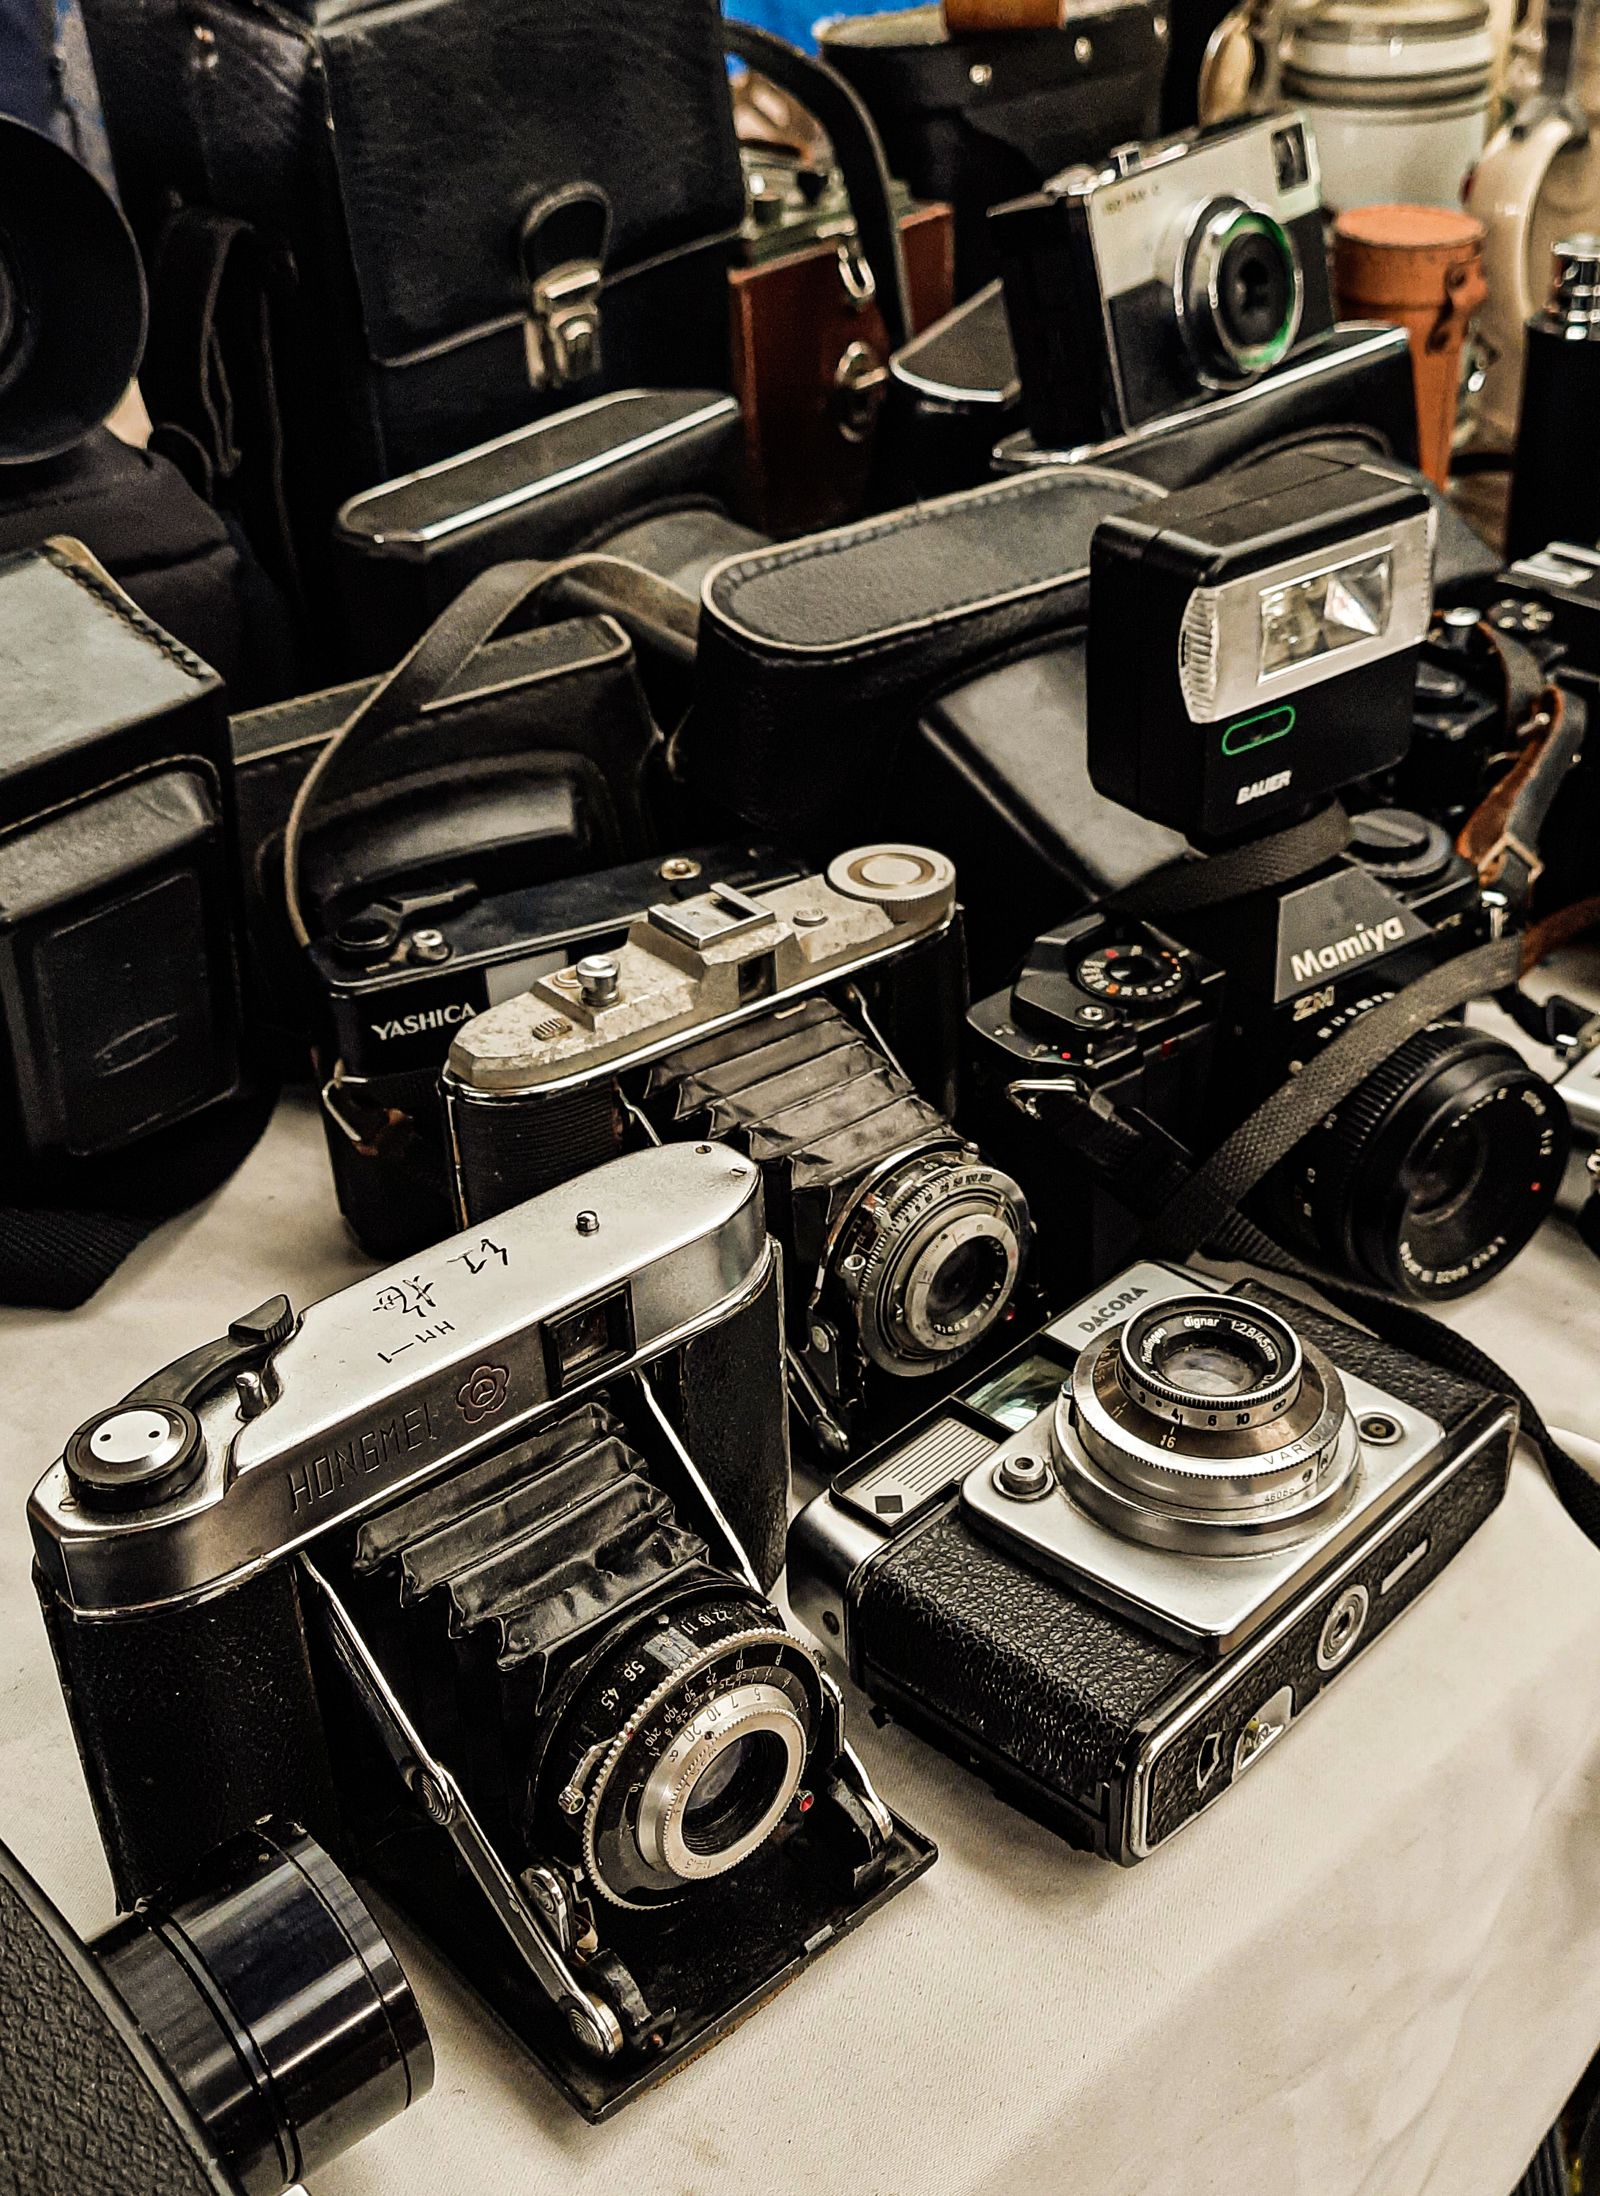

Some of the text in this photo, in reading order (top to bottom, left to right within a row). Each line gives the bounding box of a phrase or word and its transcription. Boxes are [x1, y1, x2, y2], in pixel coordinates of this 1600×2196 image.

[1290, 916, 1405, 982] Mamiya
[371, 1002, 477, 1040] YASHICA
[1078, 1287, 1148, 1333] DACORA
[1183, 1315, 1219, 1329] dignar
[1207, 1415, 1217, 1427] 6
[1235, 1412, 1250, 1426] 10
[1160, 1434, 1176, 1449] 16
[287, 1402, 437, 1513] HONGMEI
[663, 1707, 679, 1723] 100
[706, 1706, 721, 1722] 10
[683, 1723, 702, 1743] 20
